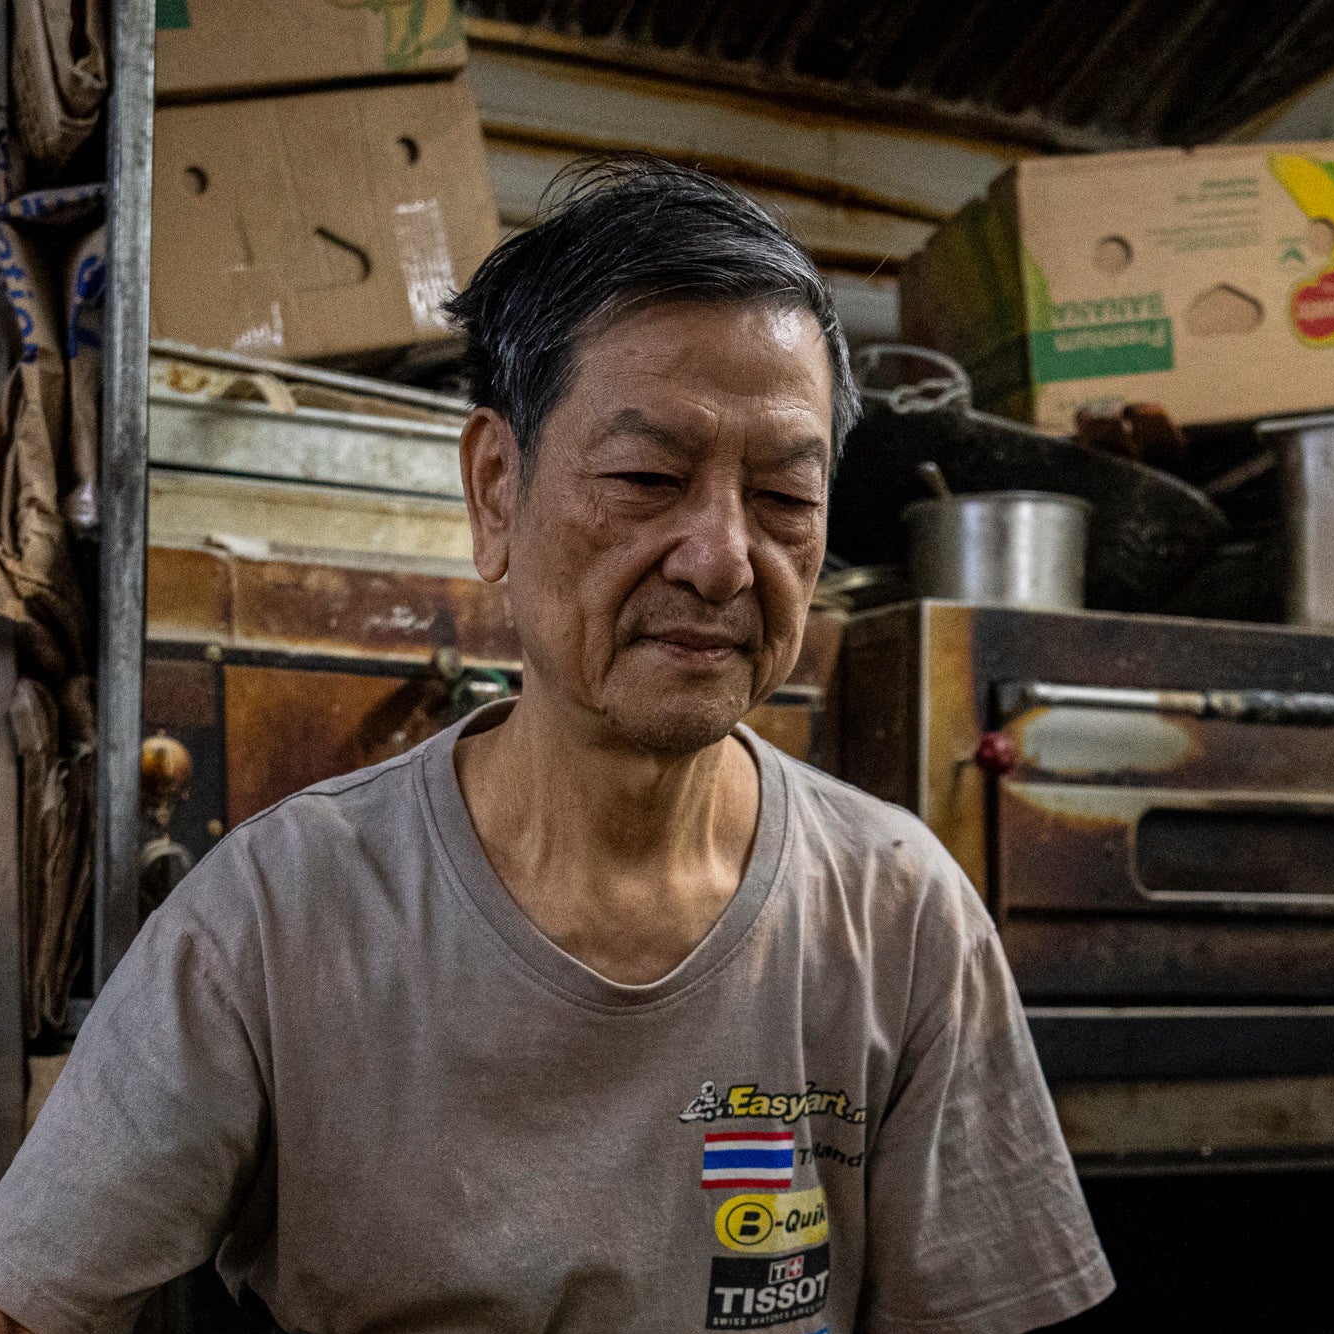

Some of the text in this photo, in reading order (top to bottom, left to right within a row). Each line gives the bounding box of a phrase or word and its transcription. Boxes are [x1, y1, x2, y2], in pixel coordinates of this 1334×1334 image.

[1052, 291, 1162, 322] BANANA
[714, 1270, 829, 1314] TISSOT
[712, 1316, 746, 1326] SWISS
